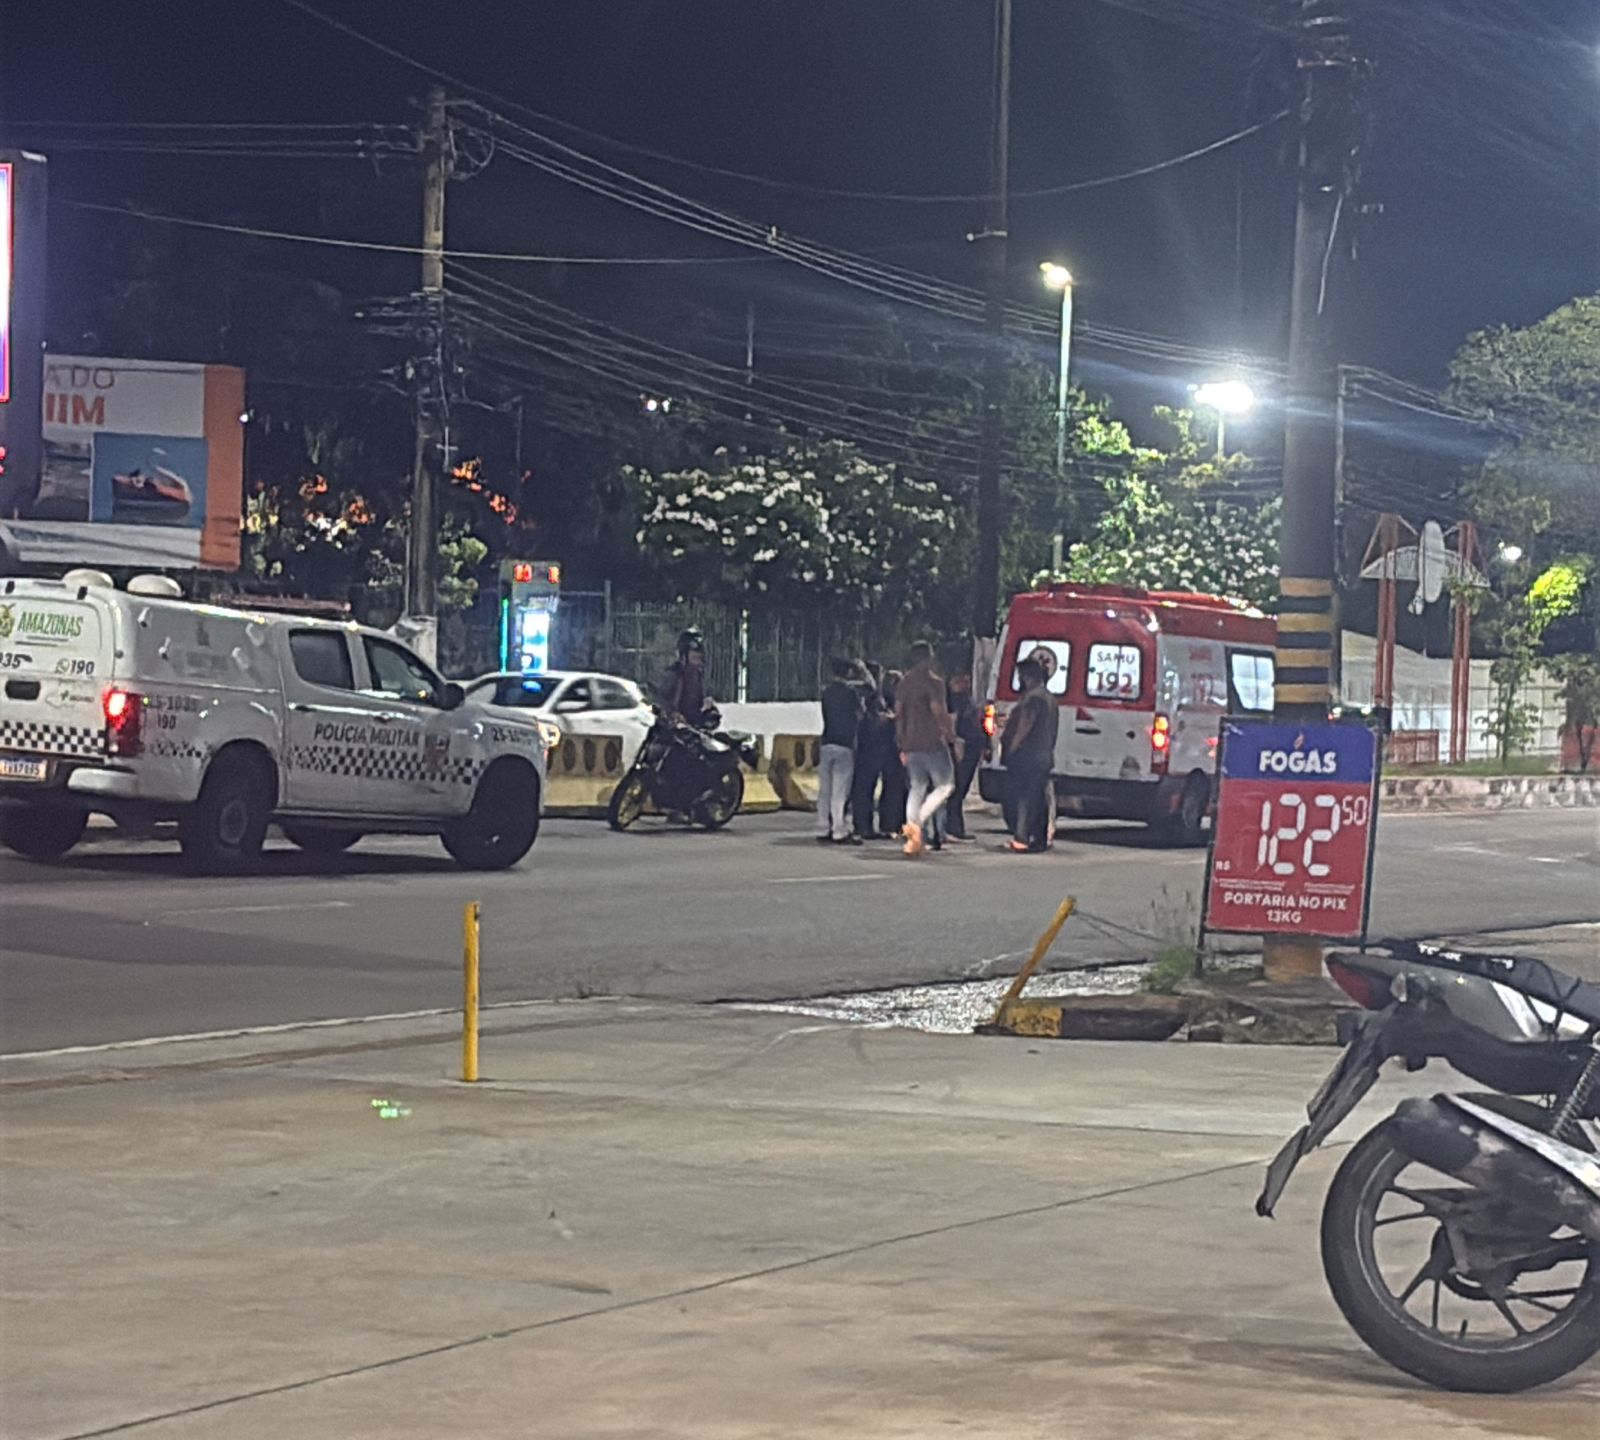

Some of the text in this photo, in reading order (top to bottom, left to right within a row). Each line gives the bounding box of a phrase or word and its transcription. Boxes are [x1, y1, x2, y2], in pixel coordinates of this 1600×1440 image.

[17, 611, 83, 637] AMAZONAS
[70, 659, 95, 675] 190
[1097, 652, 1136, 664] SAMU
[1096, 672, 1134, 695] 192
[370, 727, 419, 747] MILITAR
[1257, 793, 1368, 876] 122 50
[1224, 891, 1347, 911] PORTARIA NO PIX
[1266, 909, 1302, 923] 13KG
